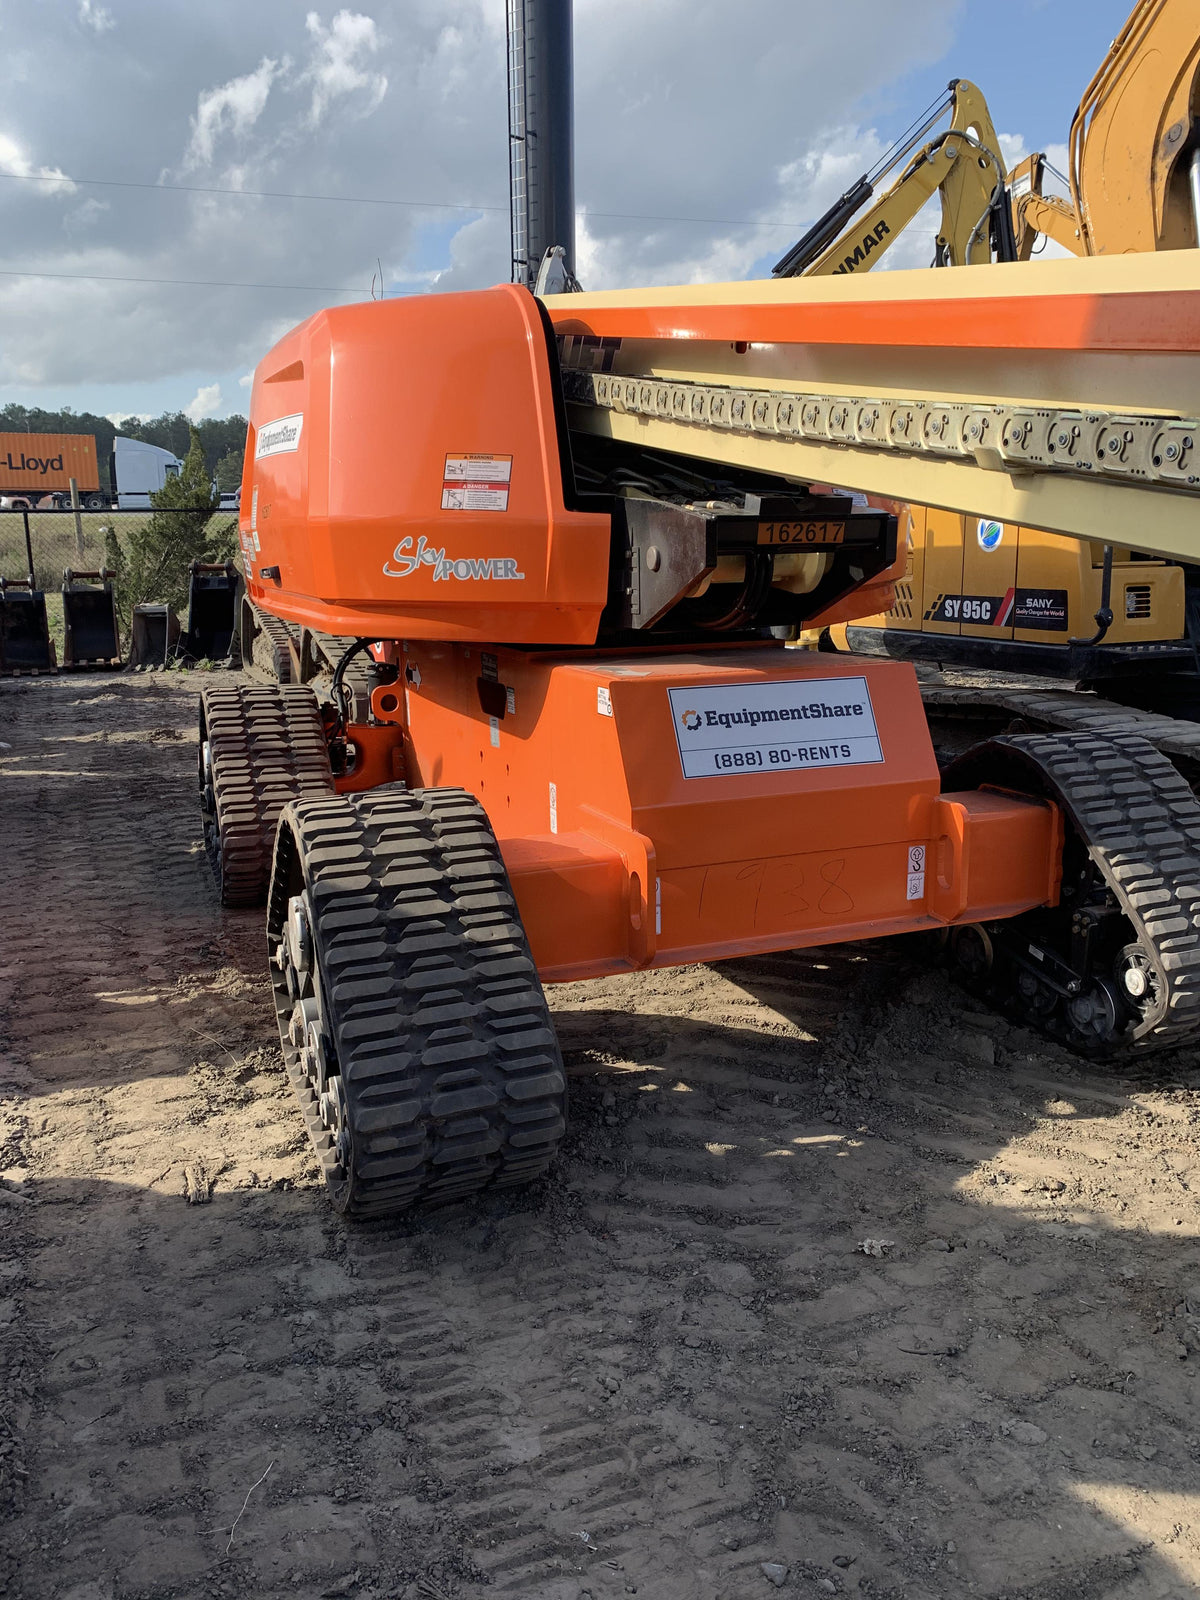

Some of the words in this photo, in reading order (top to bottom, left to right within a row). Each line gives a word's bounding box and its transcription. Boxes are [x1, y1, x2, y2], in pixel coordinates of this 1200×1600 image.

[766, 523, 844, 543] 162617
[1026, 598, 1054, 608] SANY
[705, 702, 863, 728] EquipmentShare
[715, 750, 763, 769] (888)
[769, 744, 851, 764] 80-RENTS
